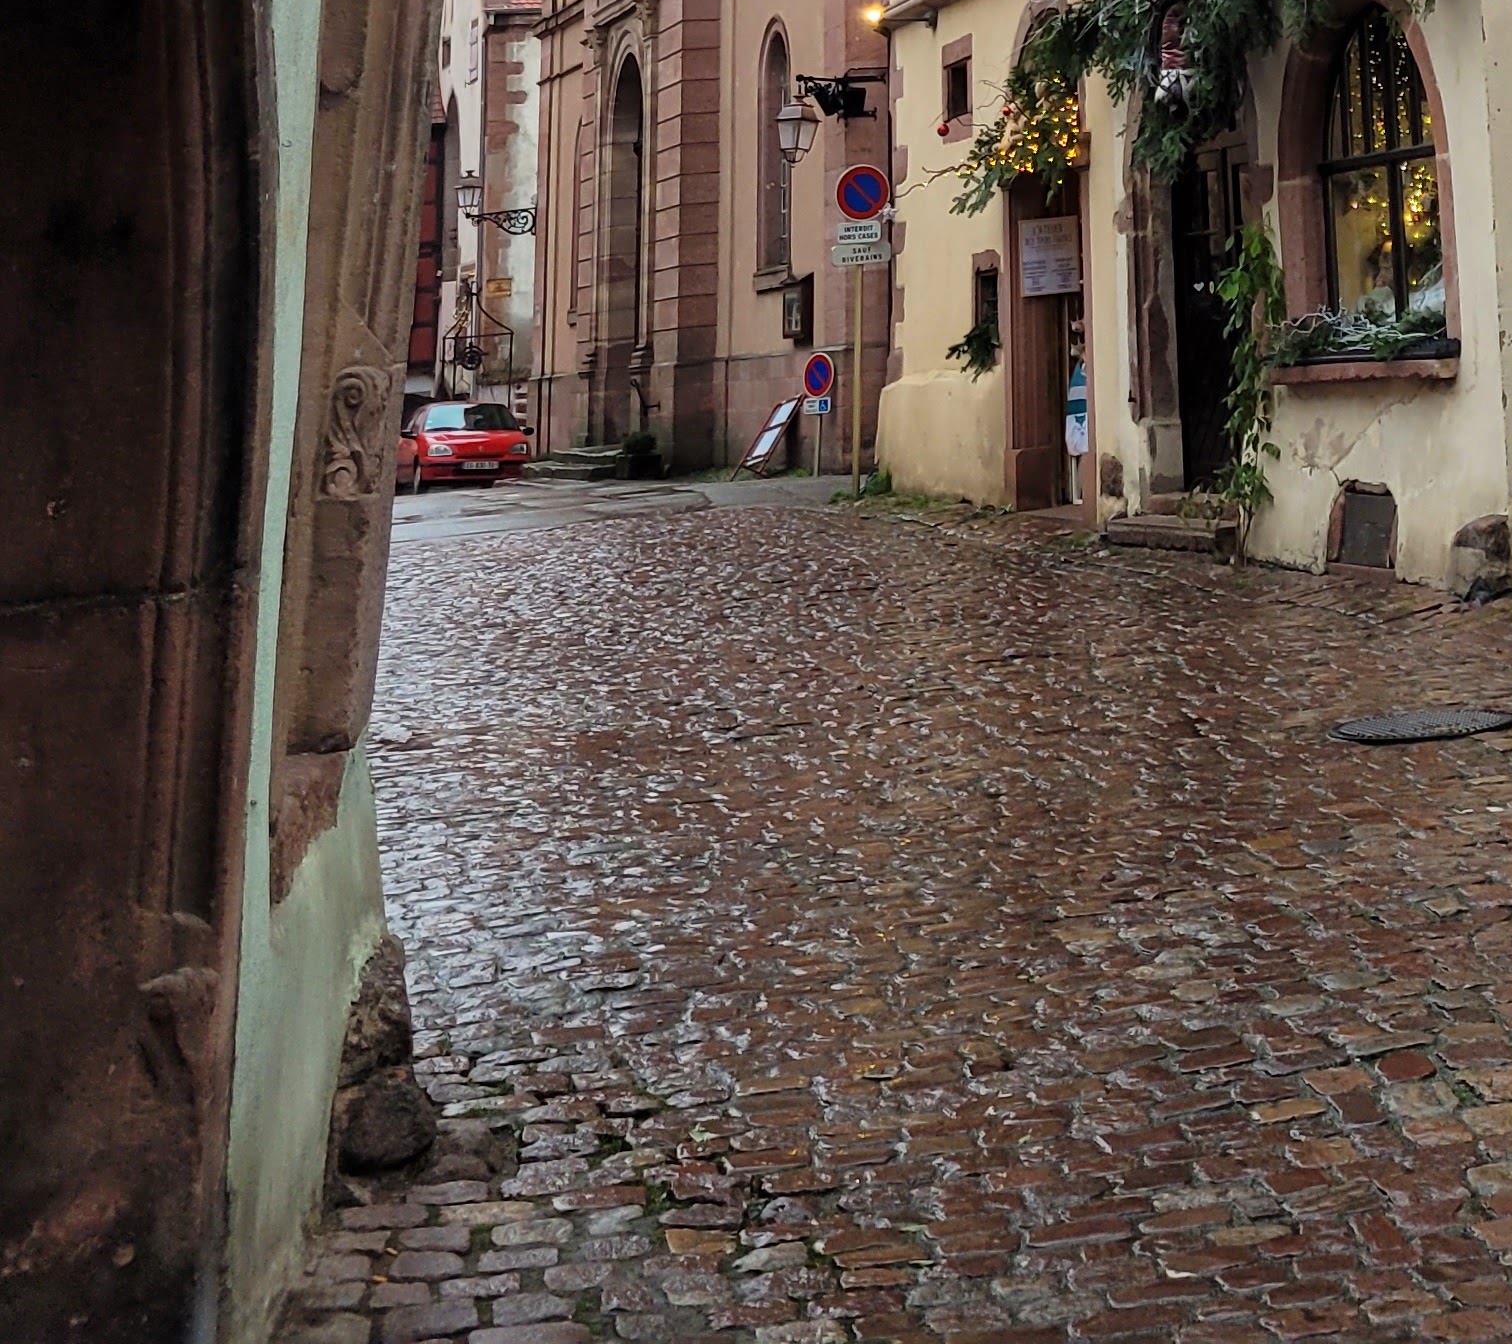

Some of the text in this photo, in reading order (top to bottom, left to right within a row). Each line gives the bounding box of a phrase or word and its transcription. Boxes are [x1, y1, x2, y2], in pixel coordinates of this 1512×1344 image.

[844, 224, 874, 233] INTERDIT
[839, 231, 878, 241] HORS CASES
[852, 246, 872, 254] SAUF
[841, 253, 883, 263] RIVERAINS
